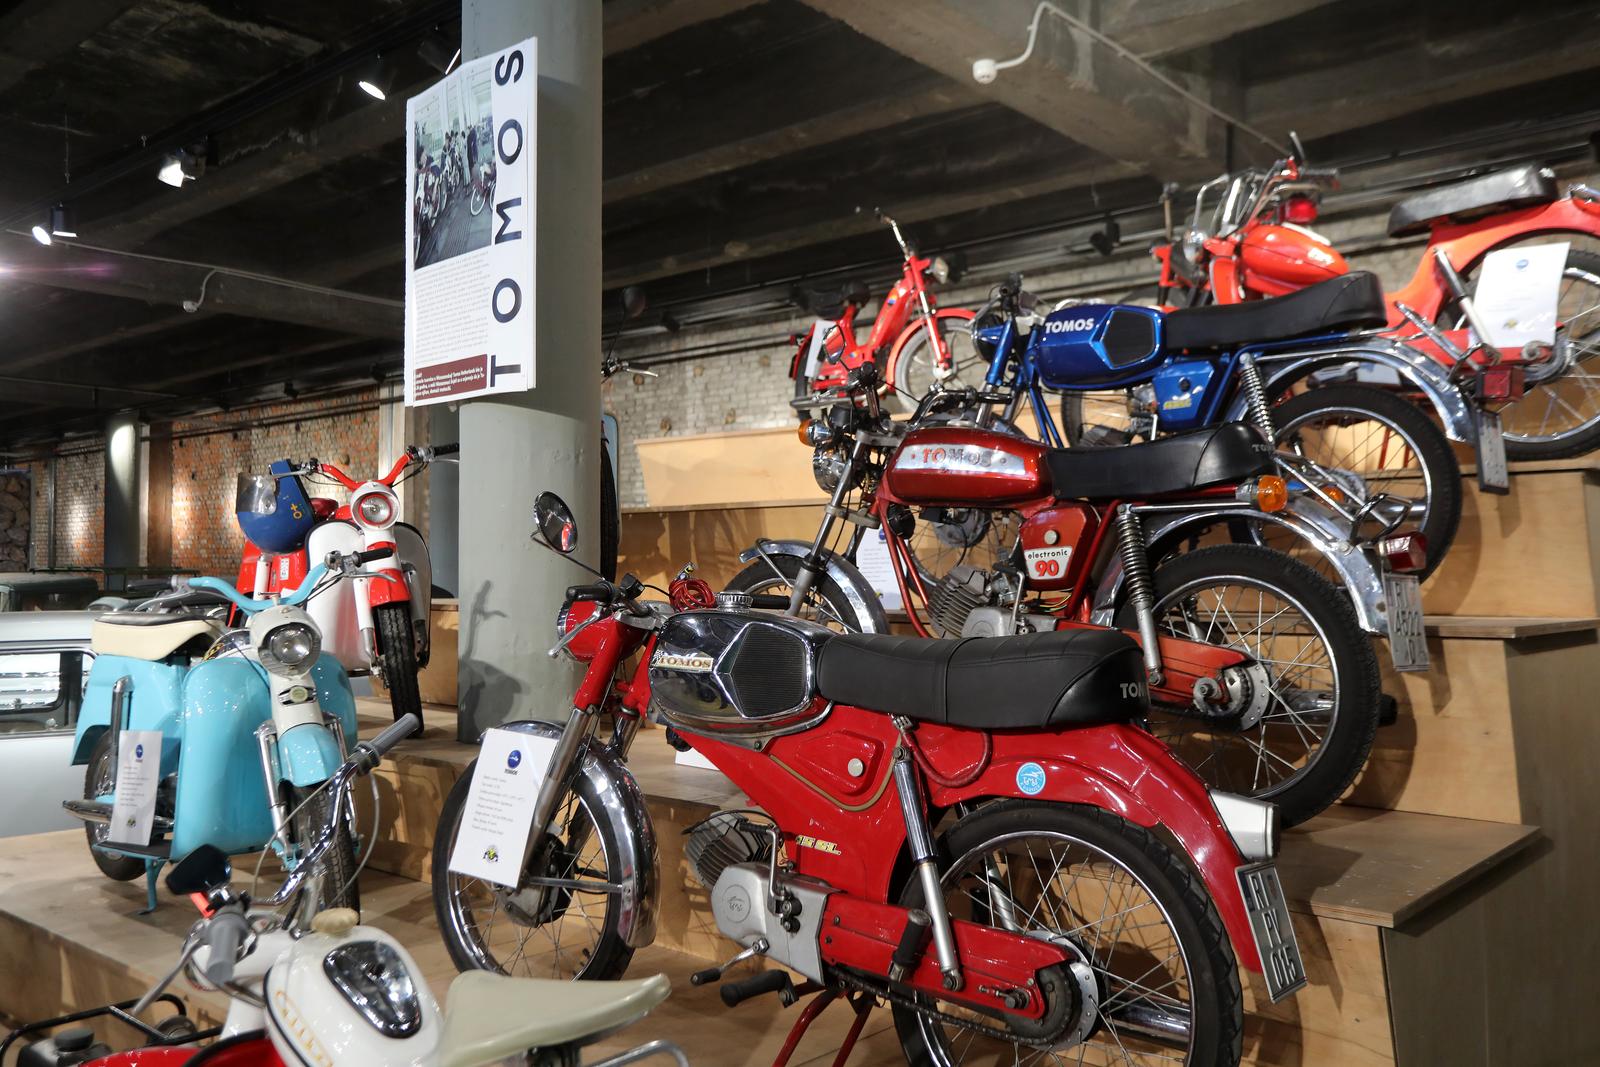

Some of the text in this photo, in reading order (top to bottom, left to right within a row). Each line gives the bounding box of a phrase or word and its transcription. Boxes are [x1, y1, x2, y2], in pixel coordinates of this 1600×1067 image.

[490, 49, 524, 387] TOMOS
[1045, 318, 1095, 334] TOMOS
[922, 447, 993, 467] TOMOS
[1027, 549, 1068, 559] electronic
[1035, 559, 1060, 577] 90
[658, 656, 711, 668] TOMOS
[1248, 871, 1270, 910] RI
[1261, 908, 1283, 949] PV
[1270, 945, 1297, 990] 015
